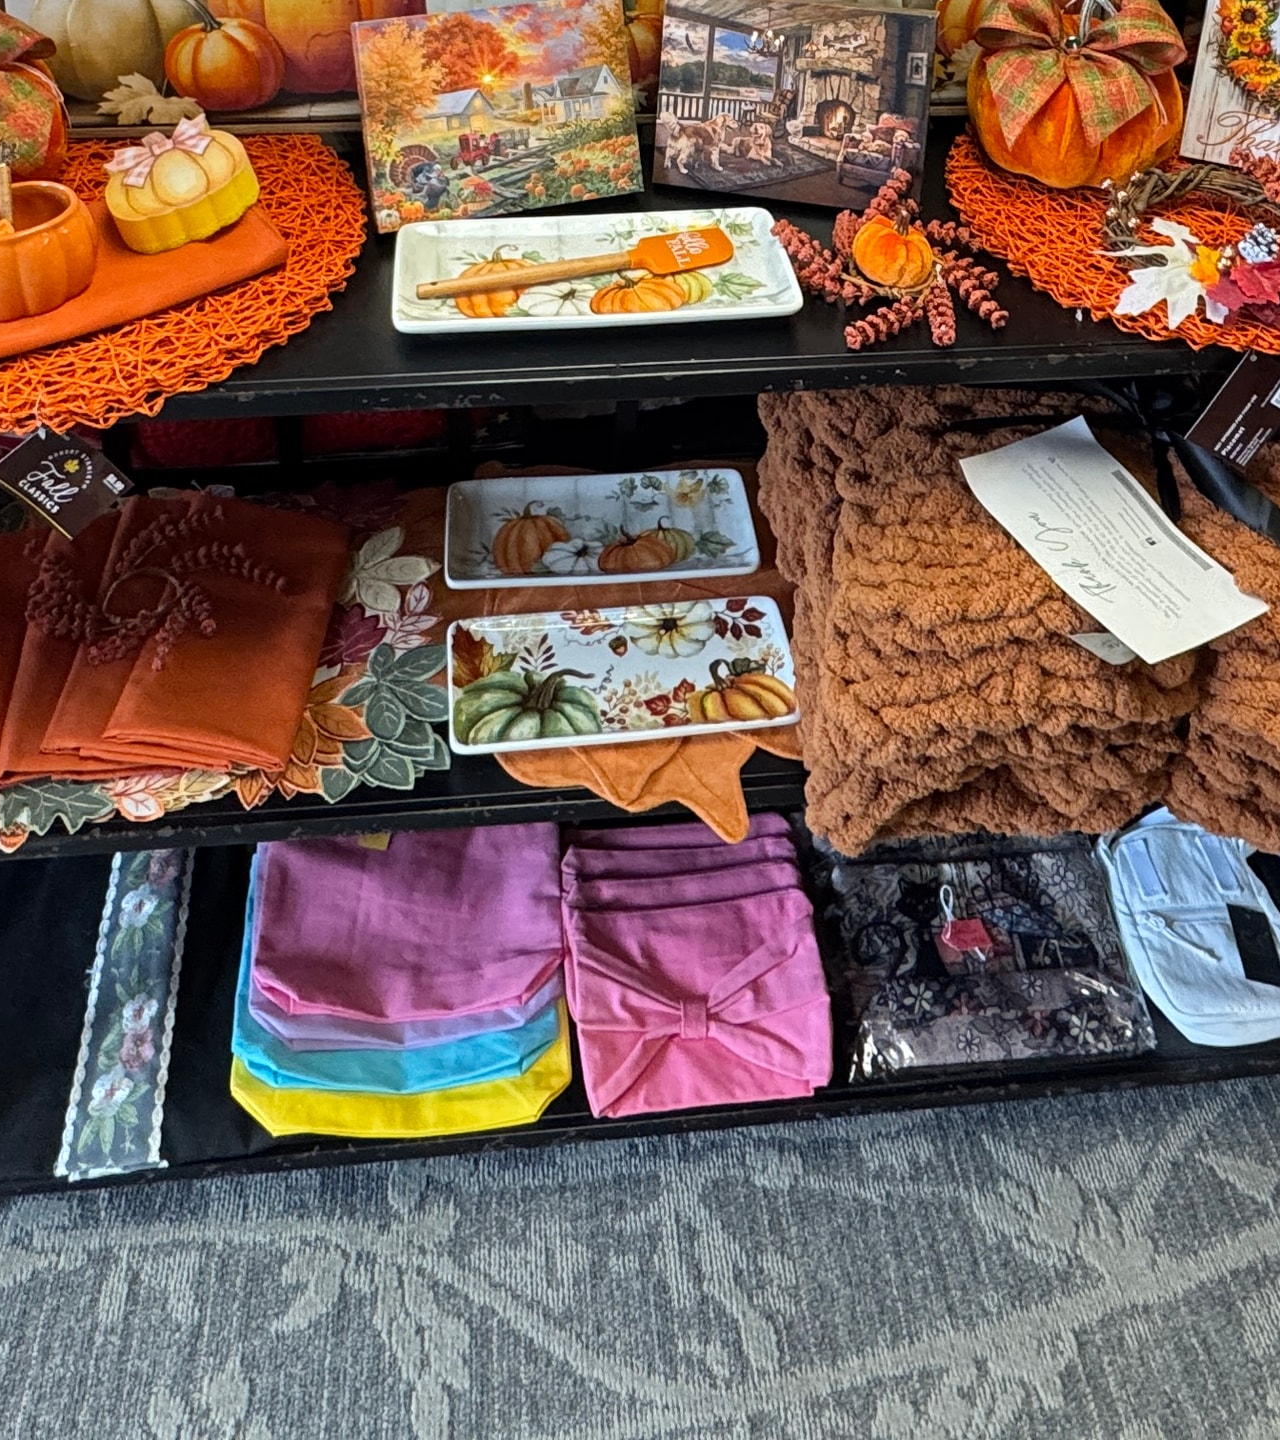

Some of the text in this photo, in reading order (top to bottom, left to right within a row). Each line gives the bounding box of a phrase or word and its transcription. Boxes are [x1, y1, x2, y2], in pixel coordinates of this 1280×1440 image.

[665, 239, 691, 268] FALL
[1221, 426, 1246, 456] Placemat
[18, 479, 60, 514] CLASSICS
[27, 460, 80, 503] Fall
[1028, 511, 1074, 551] You
